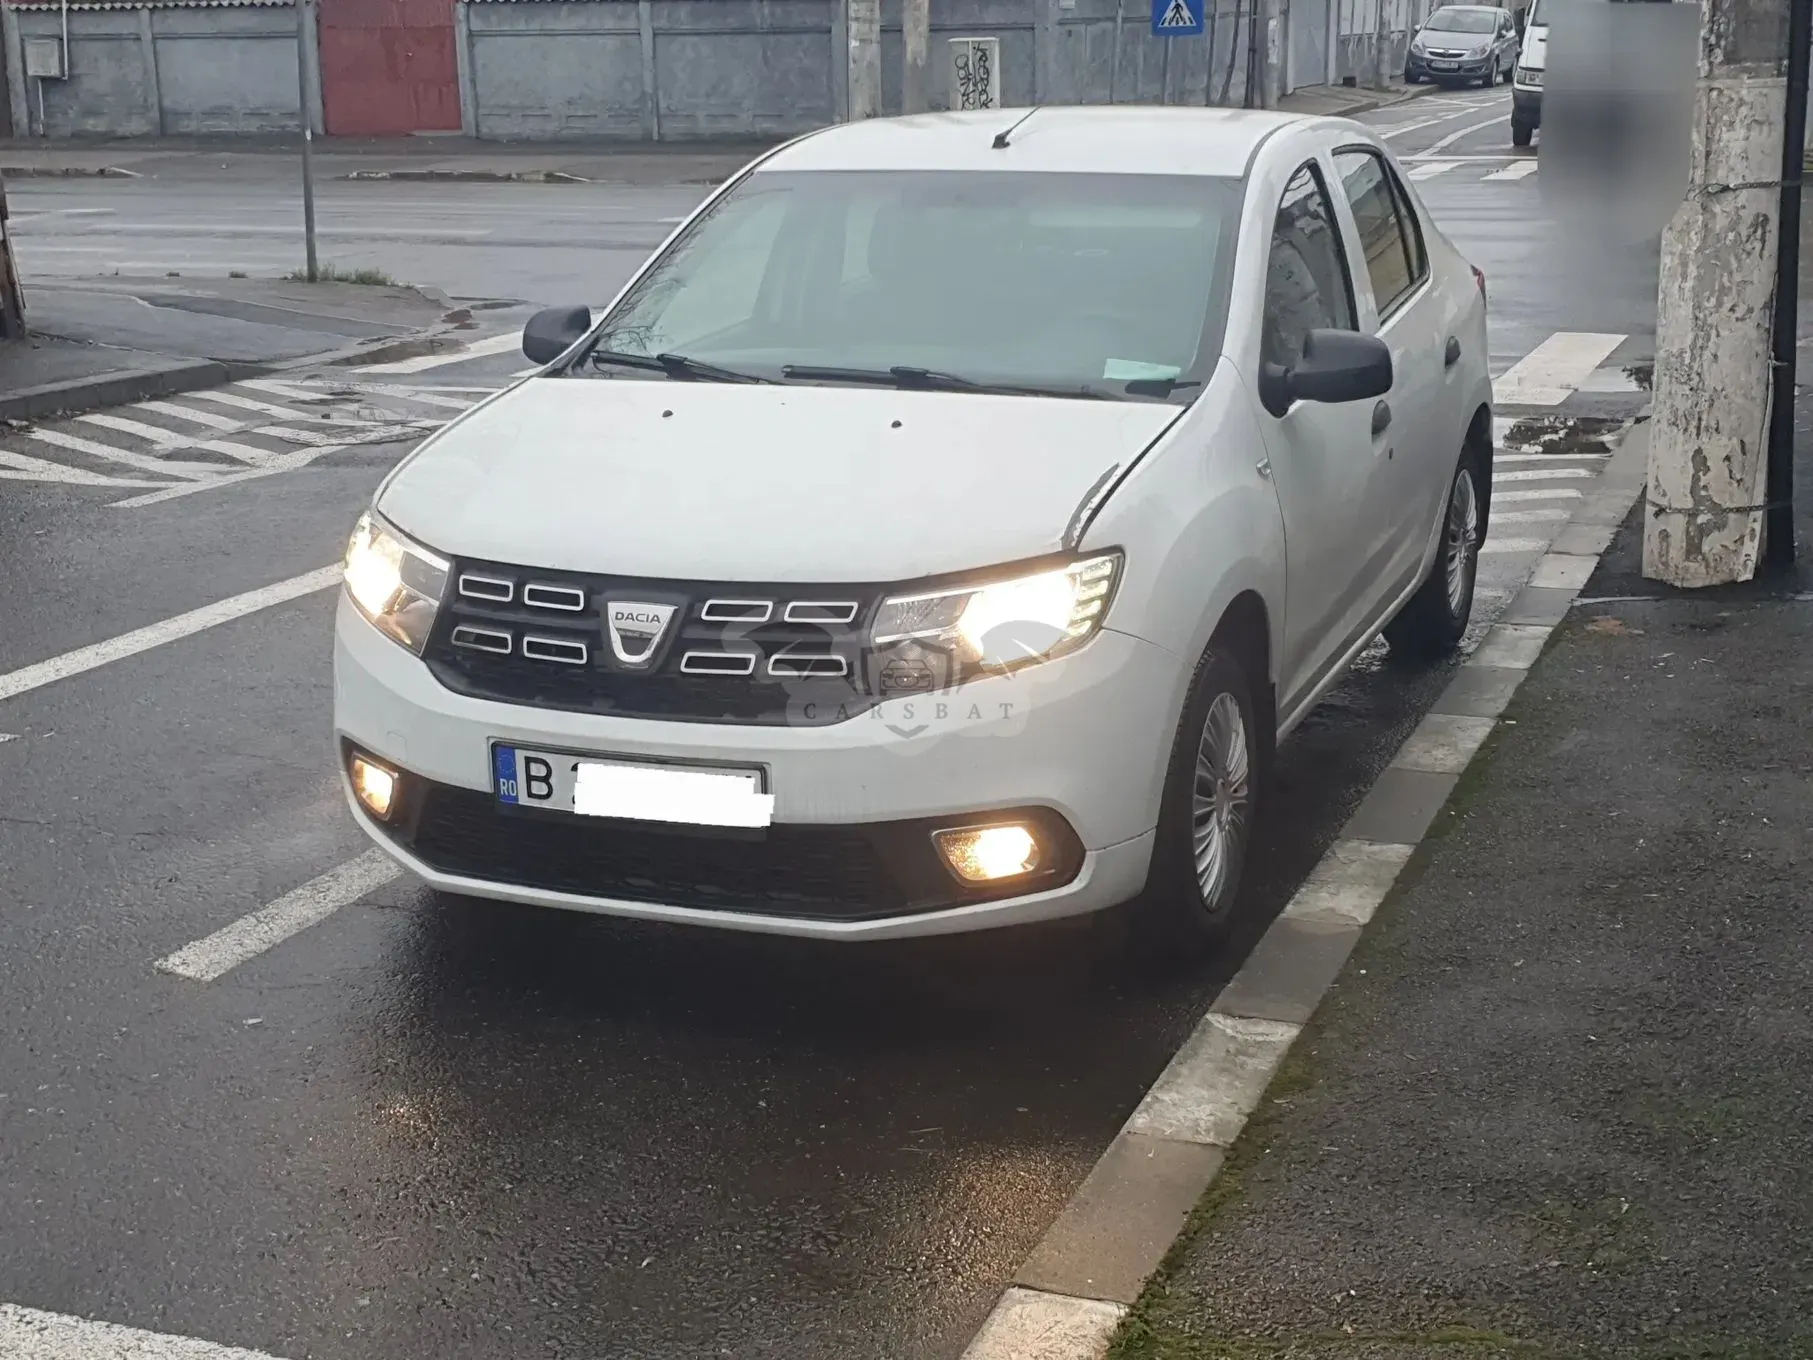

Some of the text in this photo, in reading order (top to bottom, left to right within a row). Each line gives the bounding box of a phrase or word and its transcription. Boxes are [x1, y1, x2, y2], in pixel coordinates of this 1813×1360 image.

[615, 611, 661, 624] DACIA
[500, 778, 517, 797] RO
[524, 756, 554, 800] B
